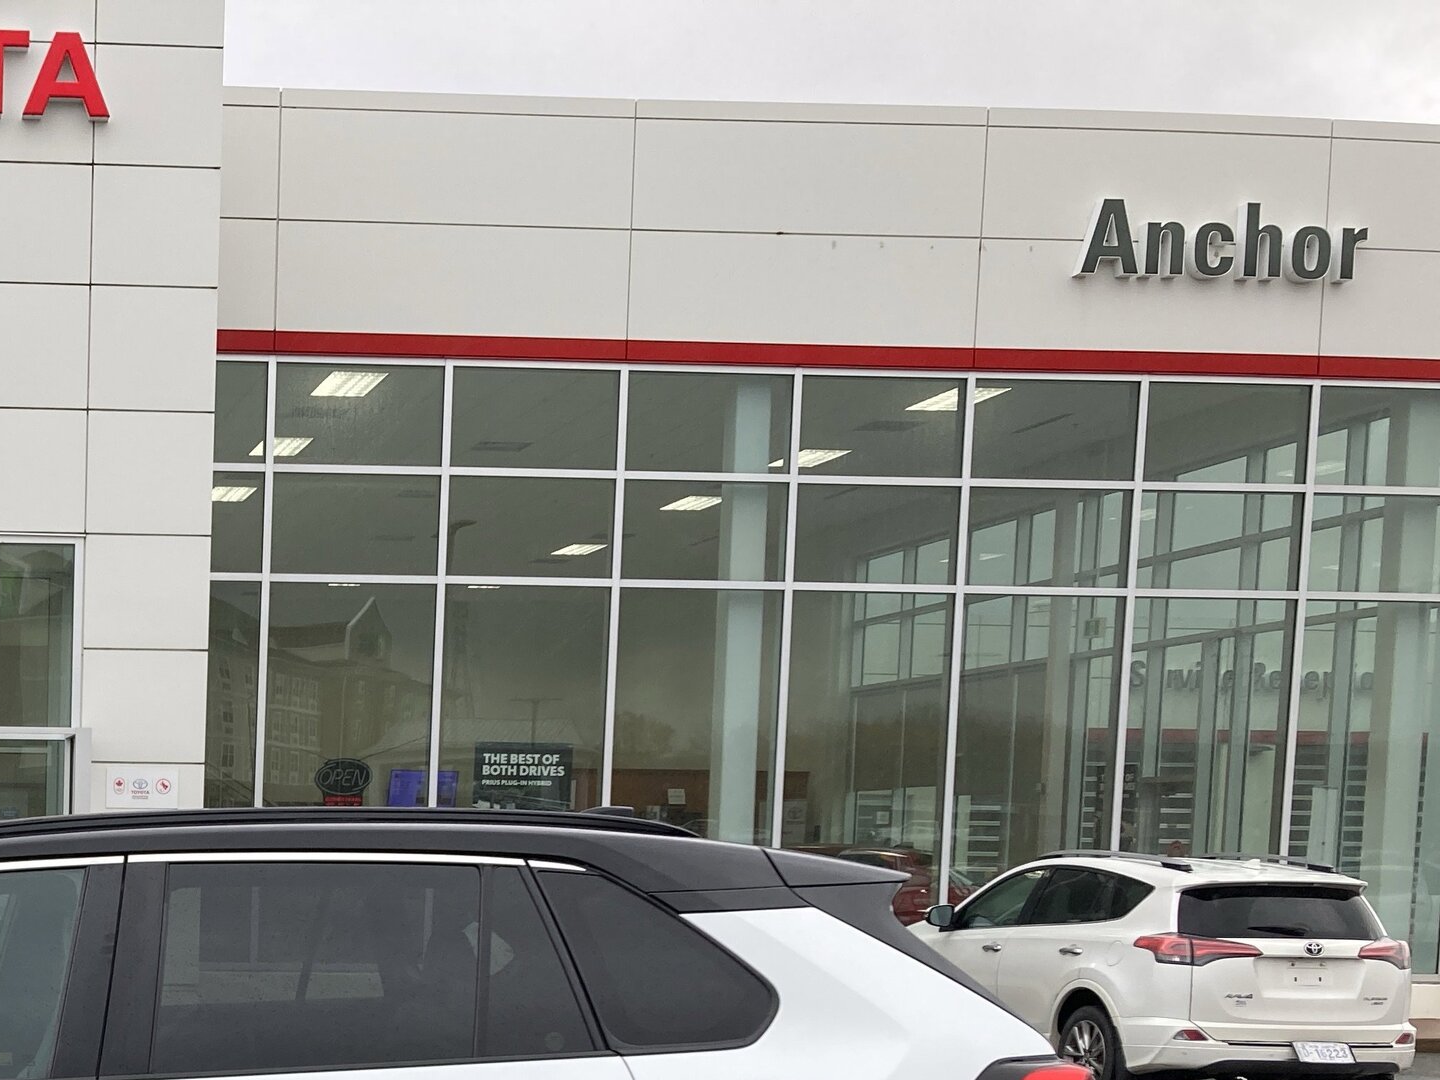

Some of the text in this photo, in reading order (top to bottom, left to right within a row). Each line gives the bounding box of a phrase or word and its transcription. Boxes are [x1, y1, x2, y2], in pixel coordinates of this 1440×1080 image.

[1073, 198, 1369, 283] Anchor
[483, 753, 560, 765] THE BEST OF
[320, 769, 367, 786] OPEN
[482, 765, 565, 777] BOTH DRIVES
